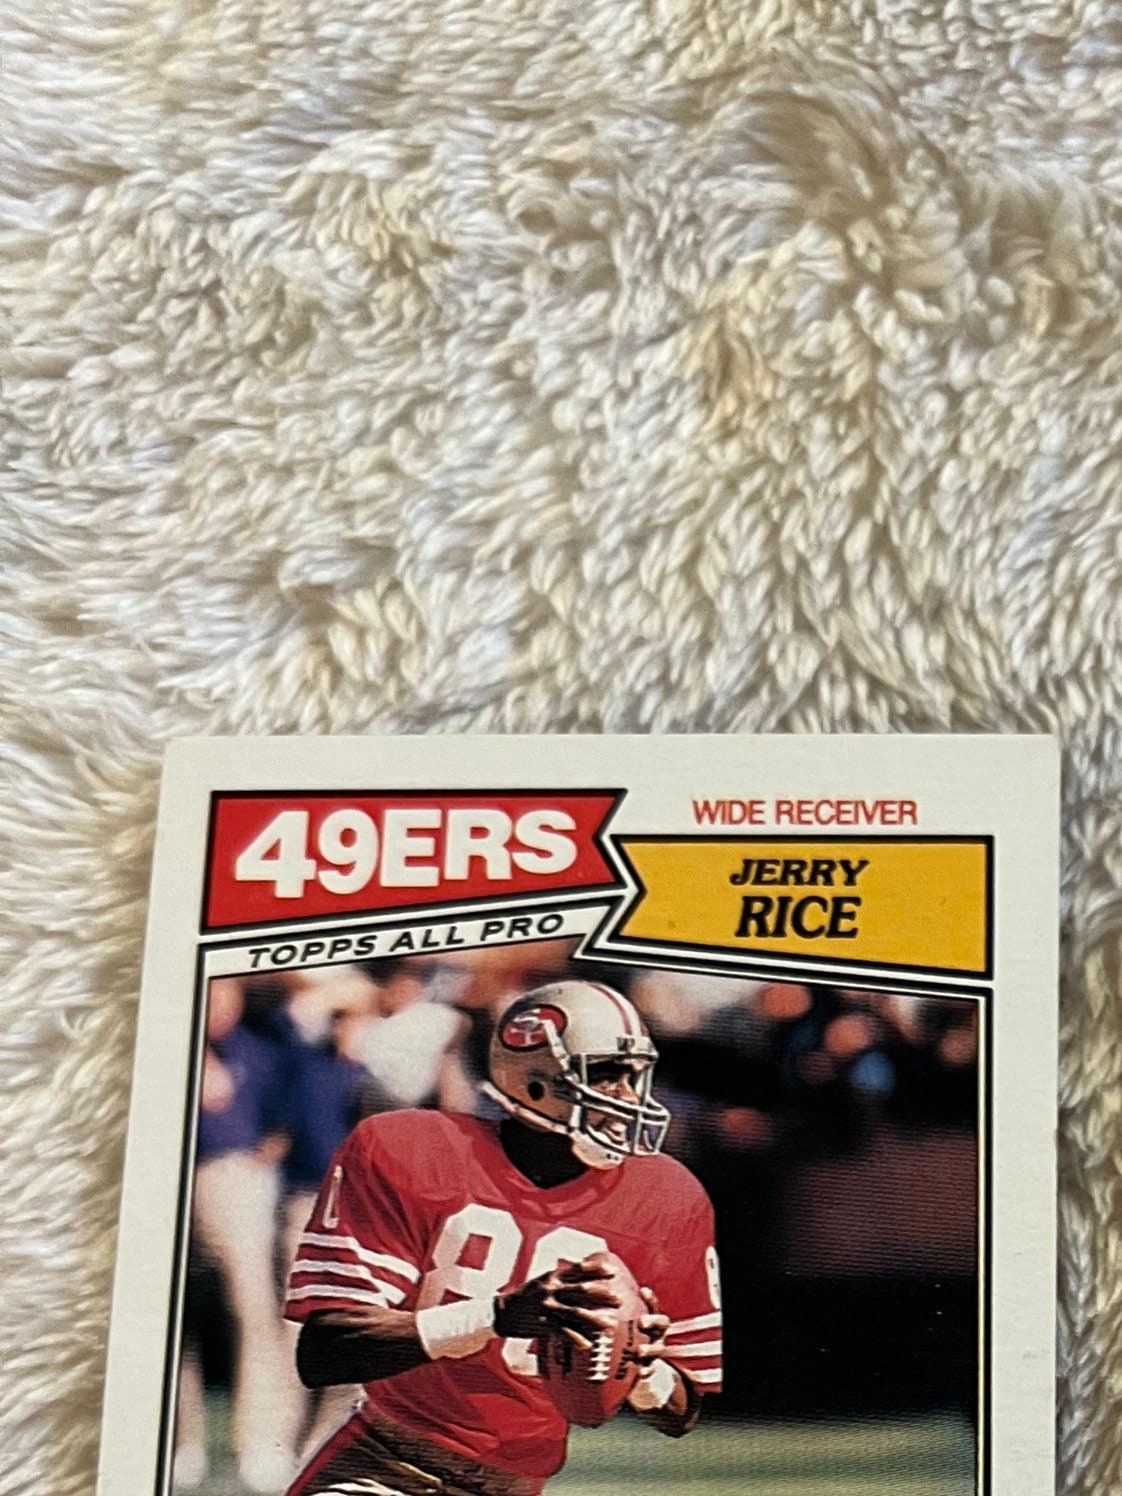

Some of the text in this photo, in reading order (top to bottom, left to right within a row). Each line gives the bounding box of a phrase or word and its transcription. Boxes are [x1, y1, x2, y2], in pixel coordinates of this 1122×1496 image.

[693, 799, 918, 825] WIDE RECEIVER
[235, 808, 578, 899] 49ERS
[729, 857, 870, 887] JERRY
[734, 895, 863, 939] RICE
[248, 914, 565, 969] TOPPS ALL PRO
